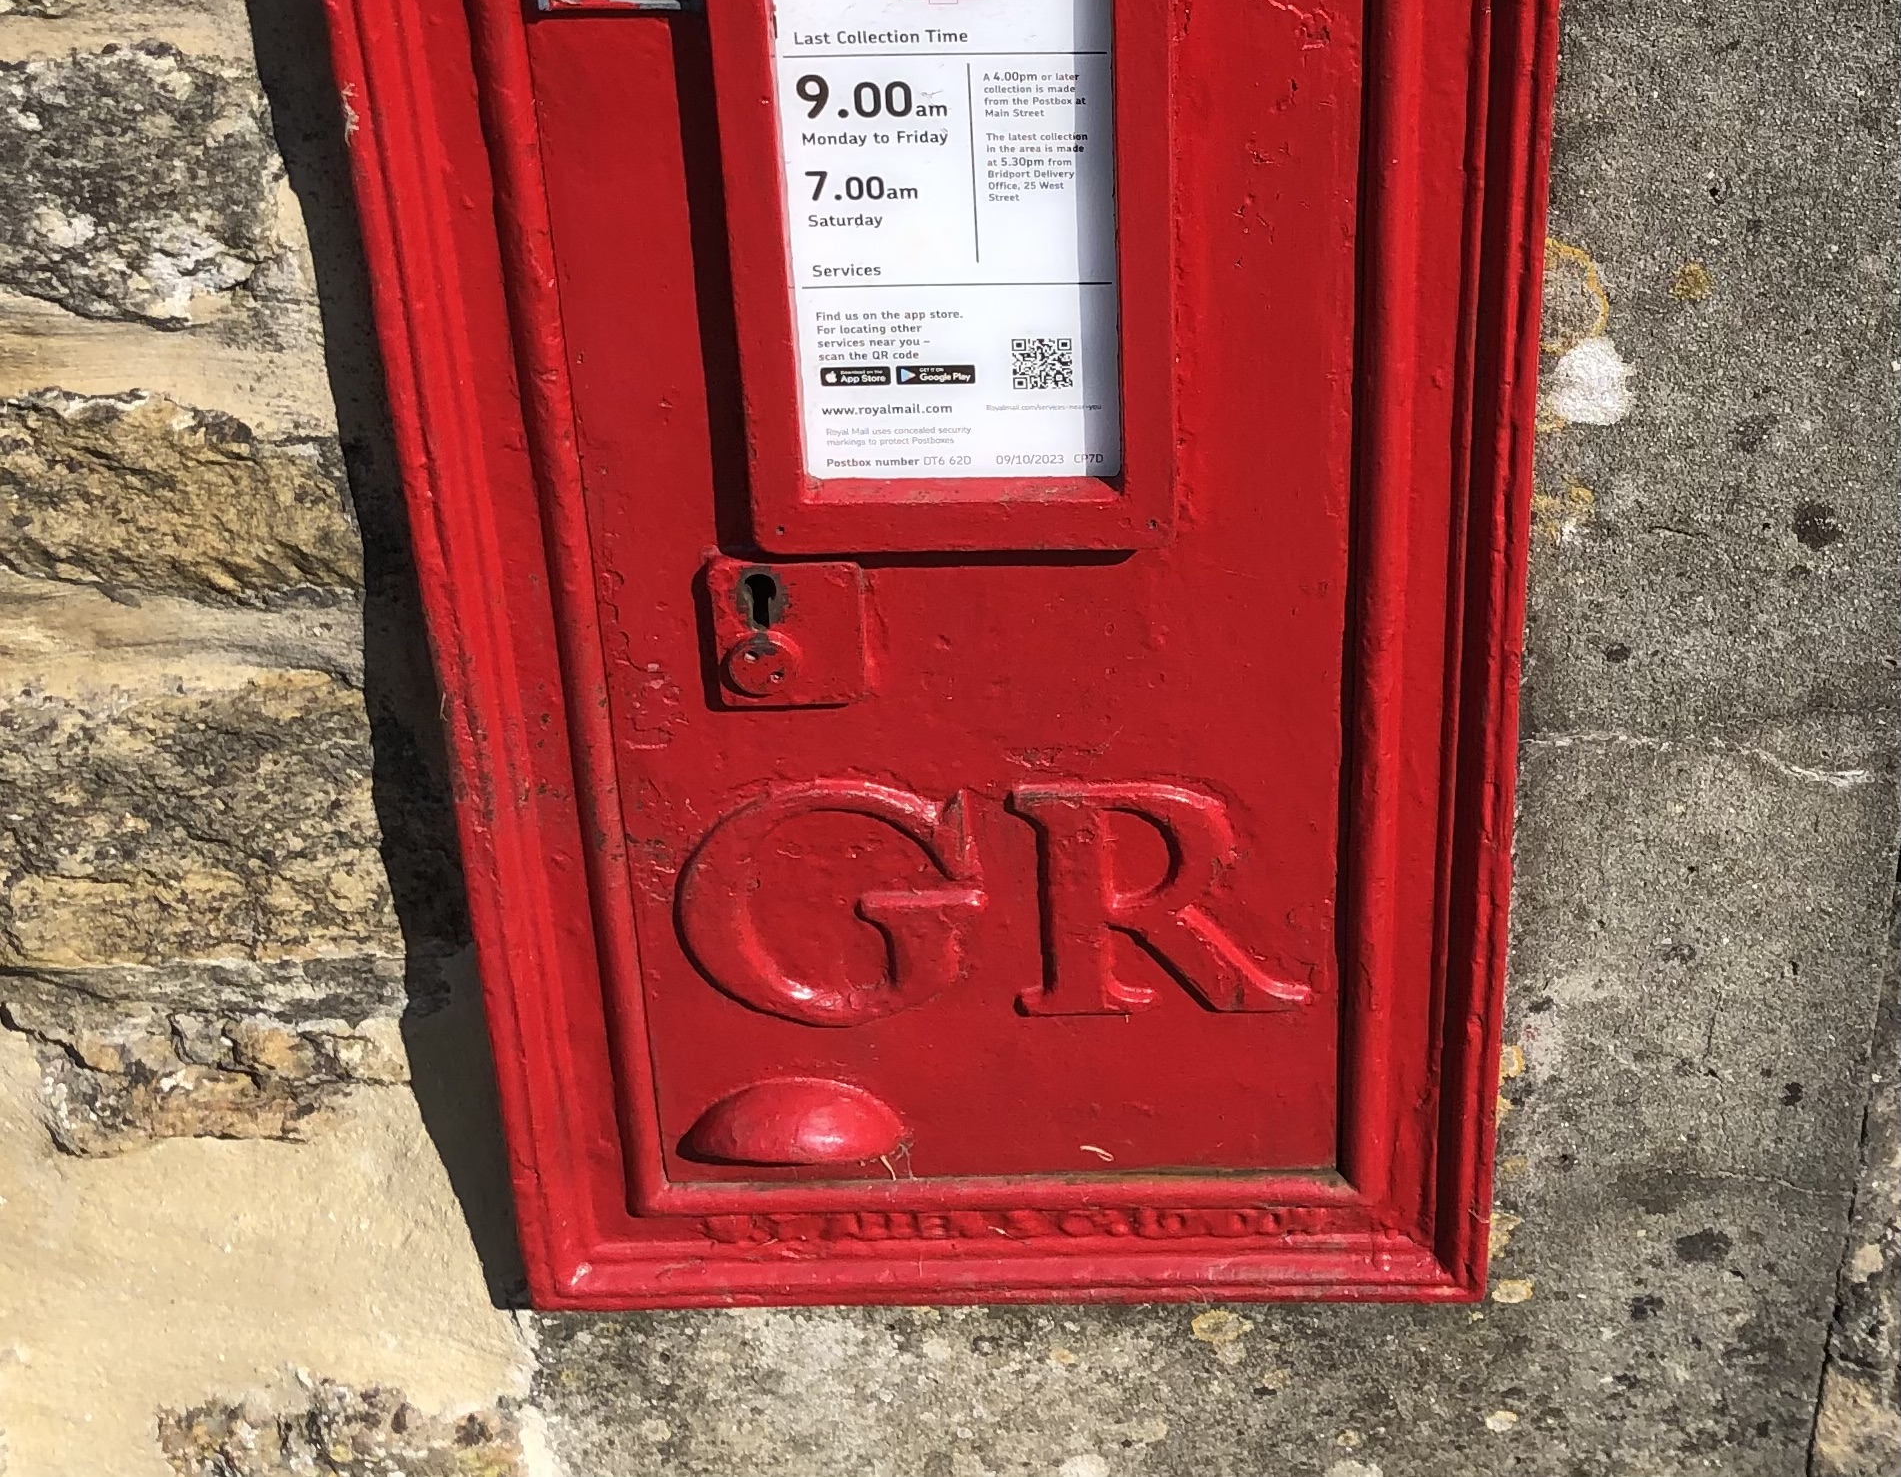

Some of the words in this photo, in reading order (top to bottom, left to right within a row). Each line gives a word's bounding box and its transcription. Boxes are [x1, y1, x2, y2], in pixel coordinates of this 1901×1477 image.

[794, 32, 831, 45] Last
[837, 30, 920, 44] Collection
[925, 29, 968, 42] Time
[983, 73, 990, 81] A
[993, 72, 1037, 82] 4.00pm
[1056, 73, 1079, 81] later
[984, 85, 1031, 93] collection
[796, 74, 948, 119] 9.00am
[984, 97, 1008, 105] from
[1012, 97, 1028, 105] the
[1033, 97, 1071, 105] Postbox
[985, 109, 1009, 117] Main
[1013, 109, 1045, 117] Street
[802, 132, 867, 146] Monday
[874, 132, 889, 144] to
[897, 130, 948, 145] Friday
[986, 133, 1004, 141] The
[1001, 157, 1044, 167] 5.30pm
[988, 170, 1030, 179] Bridport
[1034, 170, 1074, 178] Delivery
[804, 171, 918, 201] 7.00am
[989, 182, 1020, 190] Office,
[808, 214, 882, 228] Saturday
[812, 265, 881, 277] Services
[816, 312, 841, 321] Find
[881, 311, 900, 319] the
[905, 312, 925, 321] app
[930, 311, 963, 319] store.
[817, 326, 836, 334] For
[840, 325, 886, 335] locating
[891, 324, 922, 333] other
[818, 339, 865, 348] services
[899, 339, 920, 348] you
[819, 353, 844, 361] scan
[849, 352, 867, 360] the
[873, 351, 888, 360] QR
[893, 351, 919, 359] code
[920, 374, 951, 382] Google
[953, 373, 971, 382] Play
[822, 404, 952, 416] www.royalmail.com
[826, 428, 849, 437] Royal
[827, 438, 865, 446] markings
[880, 437, 909, 446] protect
[826, 459, 871, 467] Postbox
[876, 457, 919, 466] number
[924, 456, 945, 465] DT6
[996, 454, 1064, 465] 09/10/2023
[1074, 454, 1103, 463] CP7D
[672, 777, 1314, 1028] GR
